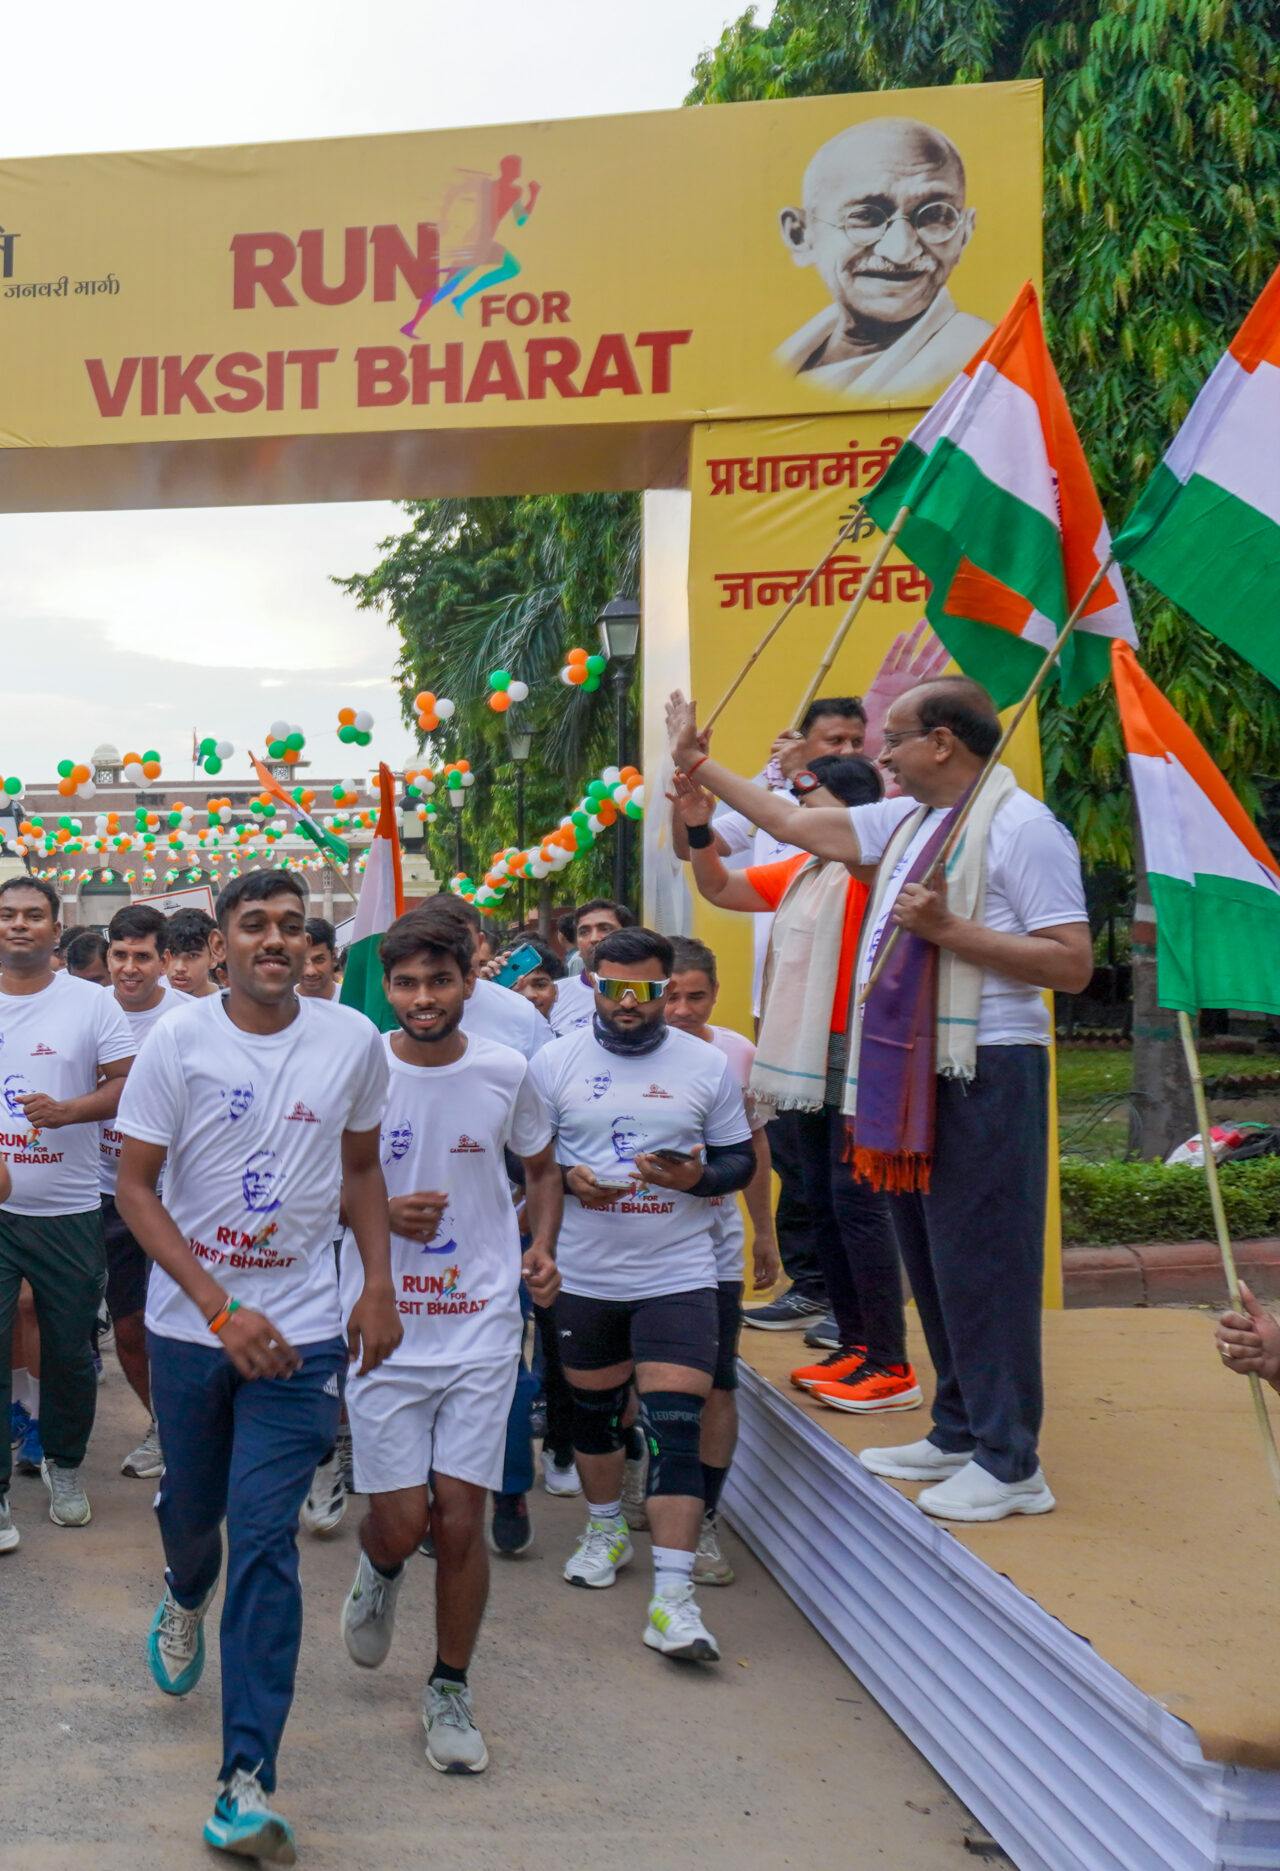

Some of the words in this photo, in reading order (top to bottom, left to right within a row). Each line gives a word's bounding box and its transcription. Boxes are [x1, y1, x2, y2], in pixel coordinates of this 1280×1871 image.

[228, 221, 440, 310] RUN
[4, 275, 69, 299] जनवरी
[480, 290, 572, 327] FOR
[84, 348, 339, 417] VIKSIT
[354, 328, 693, 408] BHARAT
[13, 1152, 64, 1164] BHARAT
[621, 1202, 676, 1214] BHARAT
[216, 1225, 257, 1250] RUN
[229, 1253, 297, 1268] BHARAT
[259, 1247, 278, 1257] FOR
[402, 1275, 444, 1293] RUN
[450, 1292, 467, 1300] FOR
[426, 1299, 488, 1315] BHARAT
